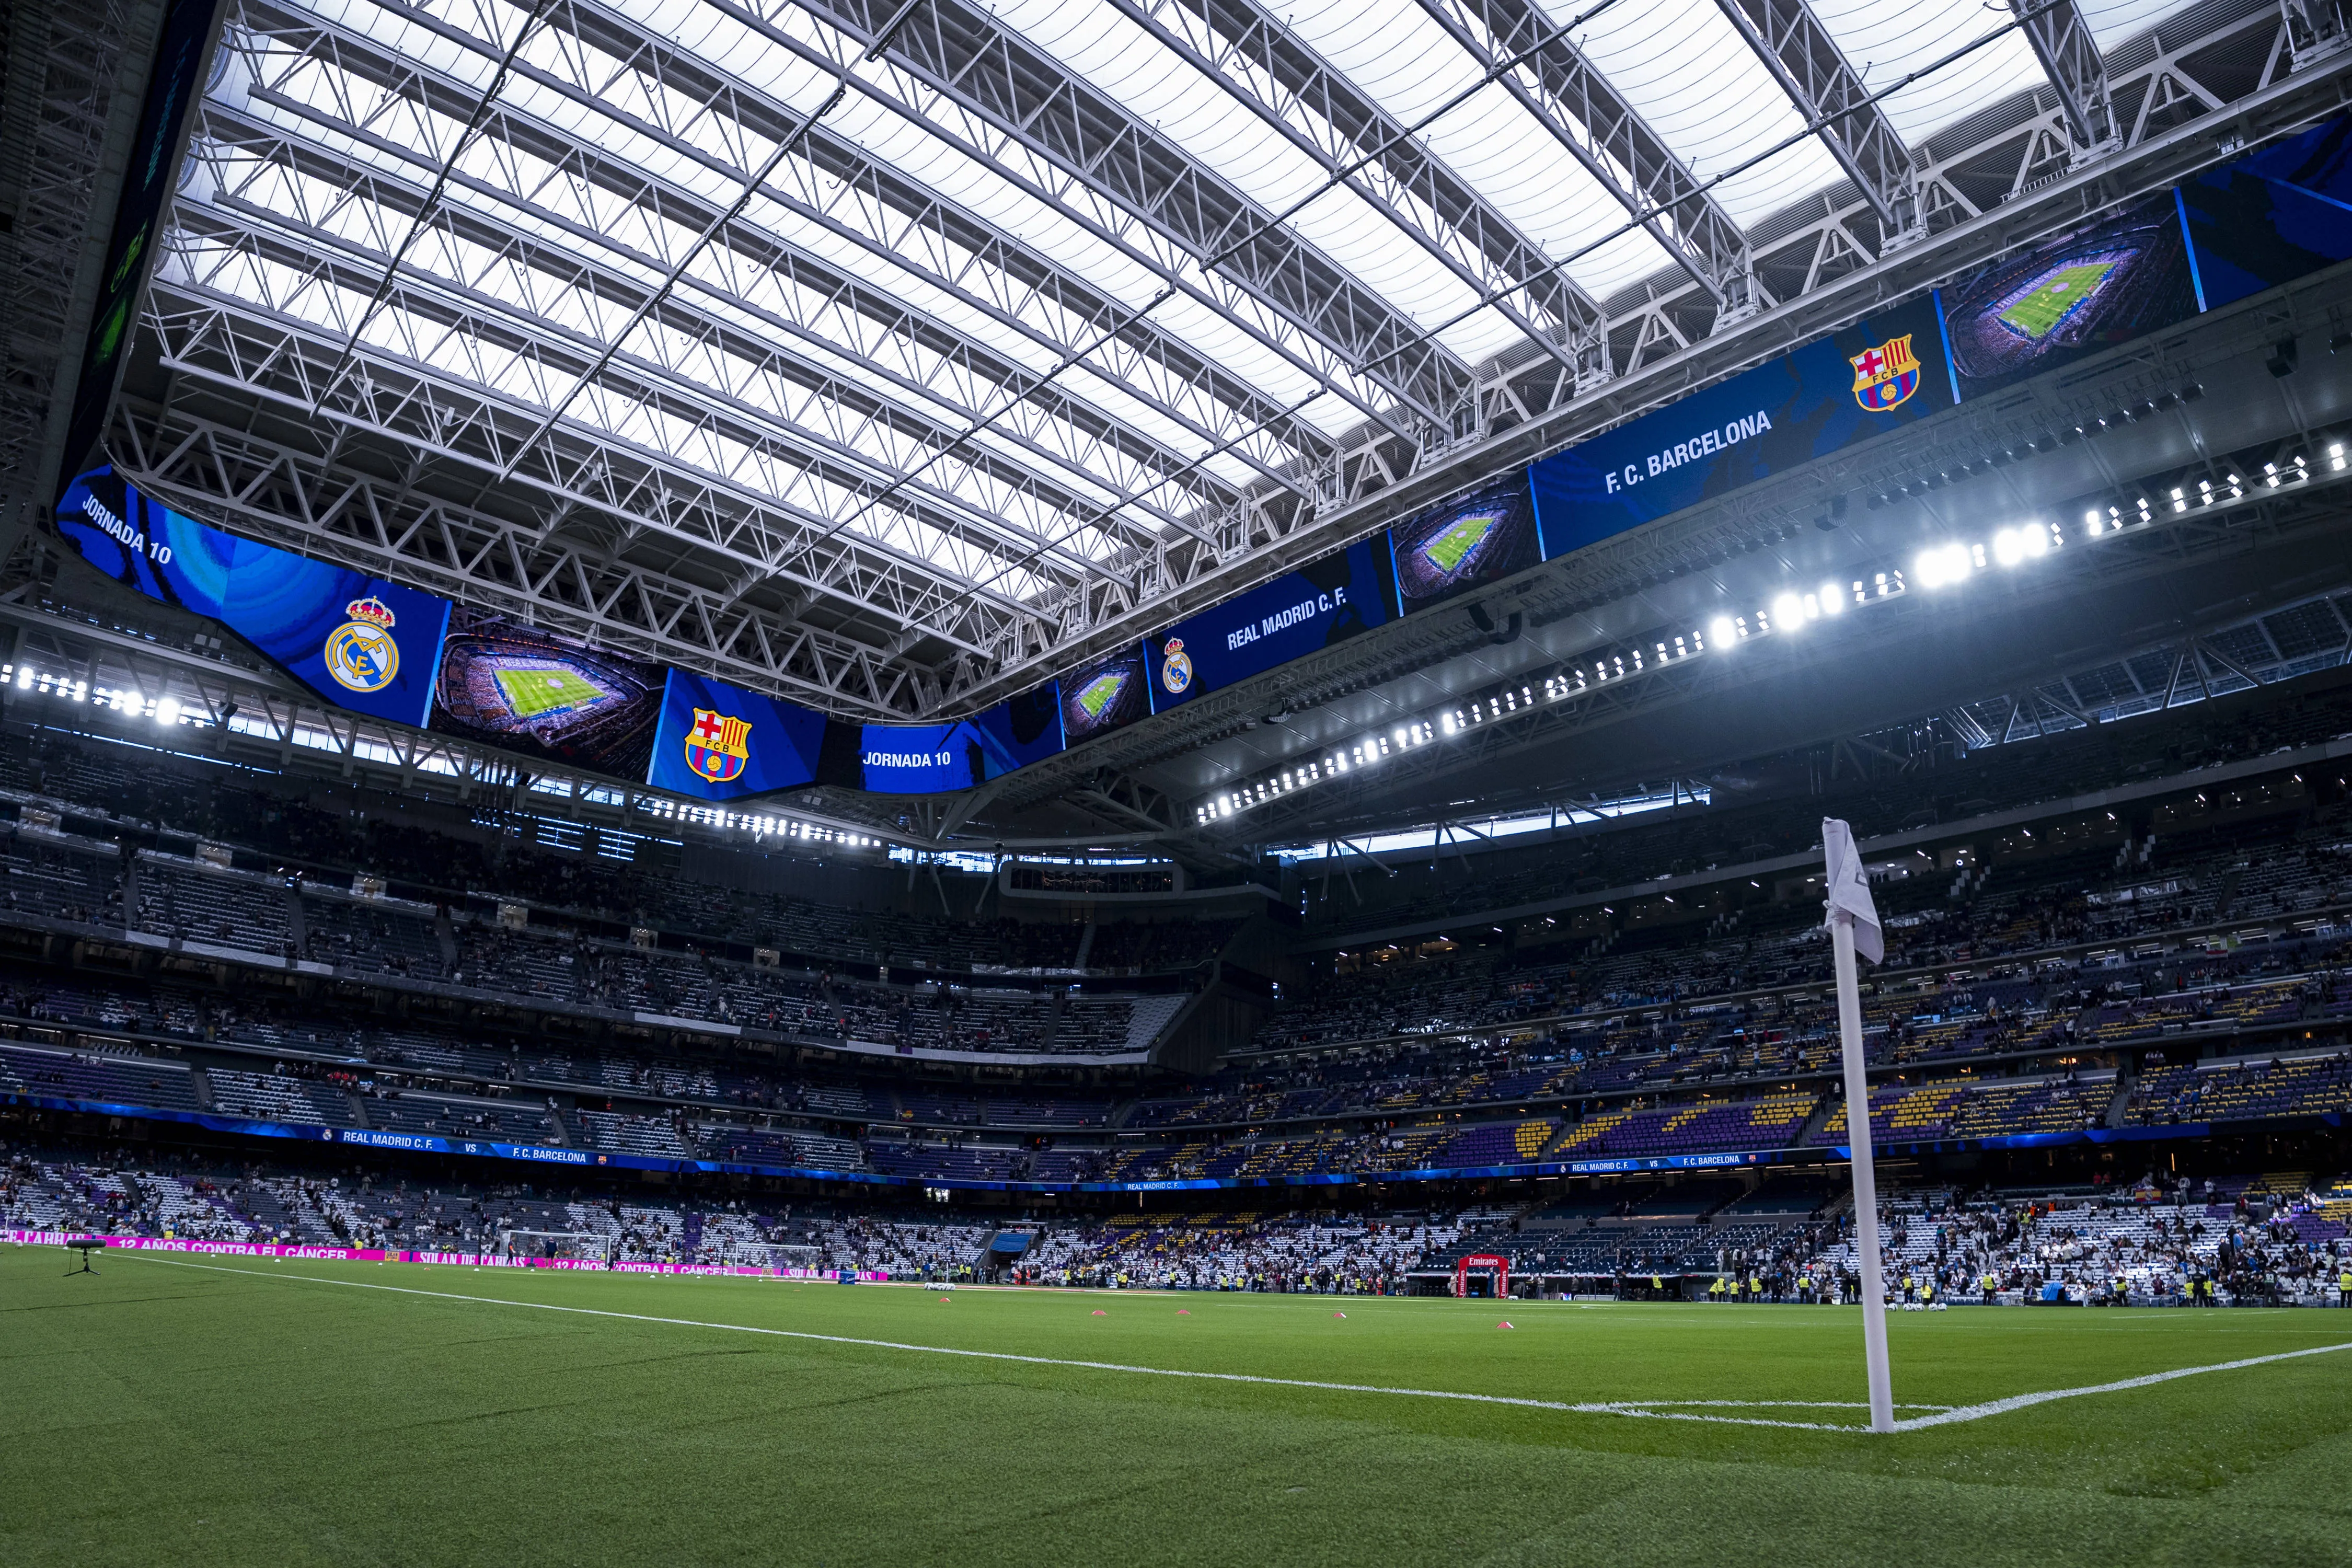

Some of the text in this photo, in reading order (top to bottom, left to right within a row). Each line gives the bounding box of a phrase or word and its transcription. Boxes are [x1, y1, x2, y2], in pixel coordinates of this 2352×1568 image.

[1605, 410, 1772, 494] F. C. BARCELONA
[82, 494, 171, 564] JORNADA 10
[1228, 587, 1346, 651] REAL MADRID C. F.
[863, 752, 951, 767] JORNADA 10
[343, 1131, 433, 1149] REAL MADRID C. F.
[465, 1143, 477, 1152] VS
[513, 1147, 586, 1163] F. C. BARCELONA
[1699, 1155, 1740, 1165] BARCELONA
[1572, 1163, 1588, 1172] REAL
[1590, 1162, 1615, 1171] MADRID
[1616, 1161, 1623, 1170] C.
[119, 1239, 136, 1249] 12
[141, 1238, 187, 1251] AÑOS
[191, 1243, 257, 1255] CONTRA
[285, 1246, 347, 1259] CÁNCER
[461, 1254, 476, 1265] DE
[556, 1261, 569, 1269] 12
[572, 1260, 606, 1271] AÑOS
[610, 1263, 659, 1273] ONTRA
[681, 1265, 728, 1275] CÁNCER
